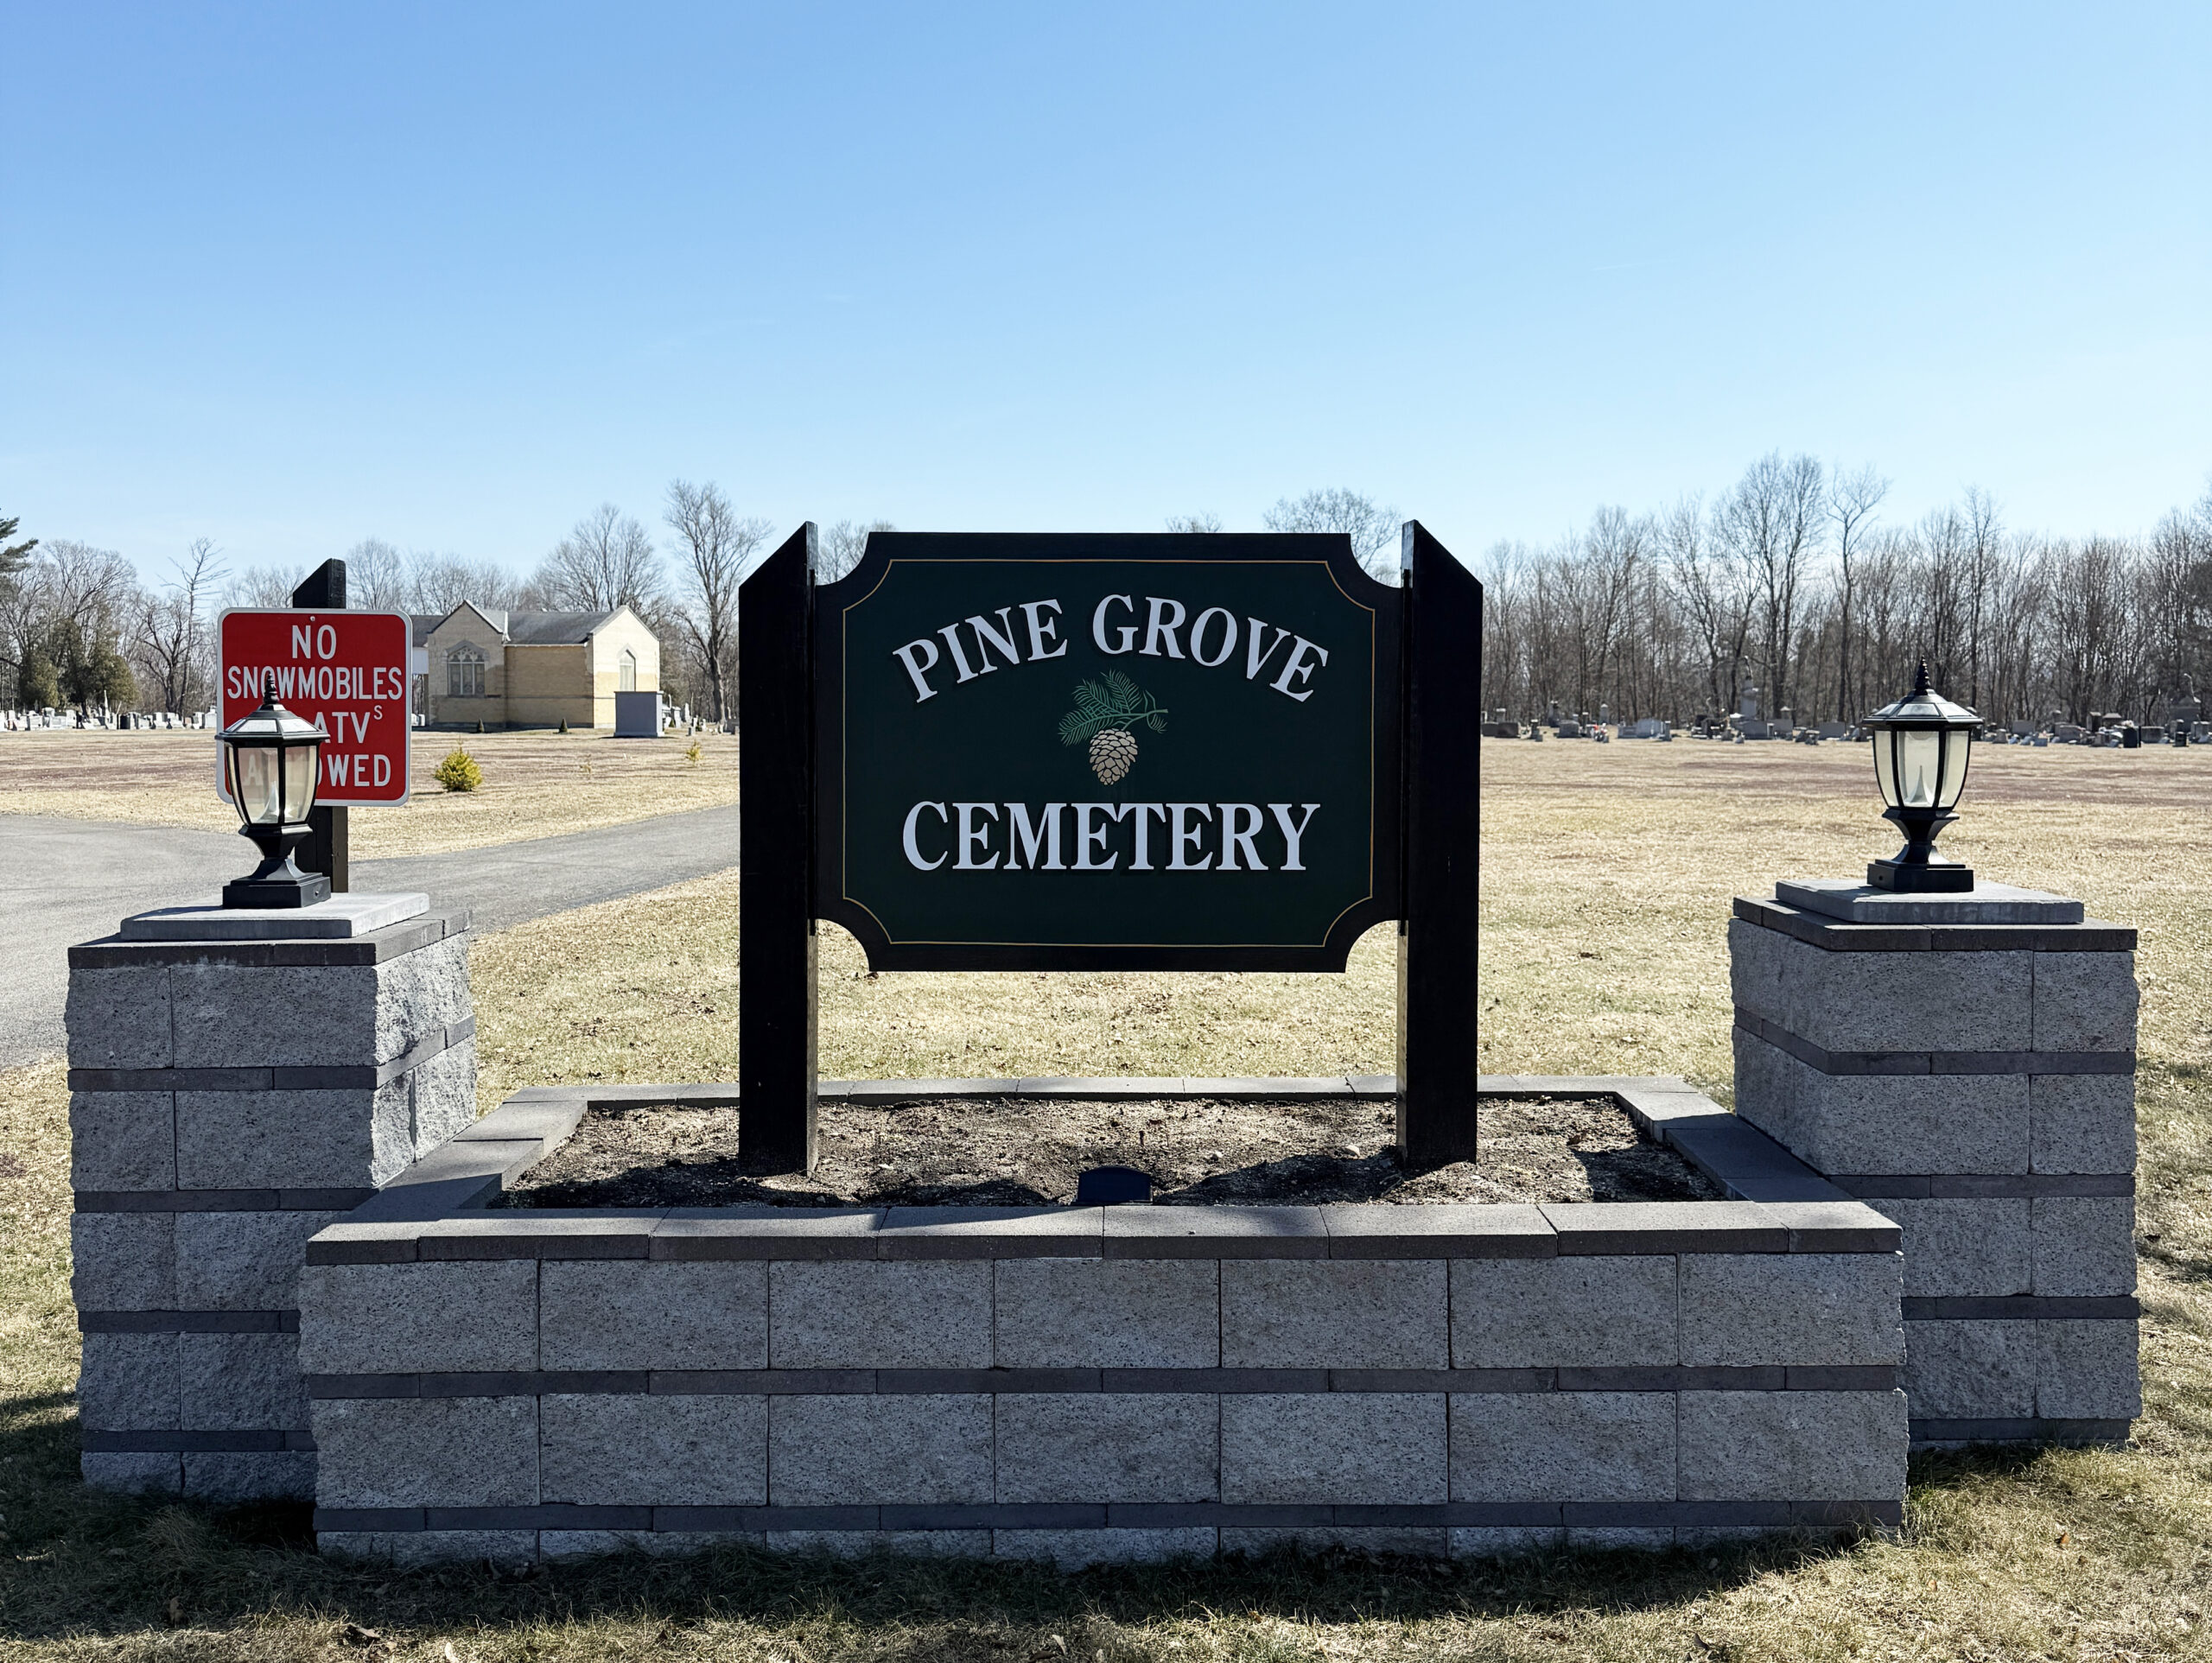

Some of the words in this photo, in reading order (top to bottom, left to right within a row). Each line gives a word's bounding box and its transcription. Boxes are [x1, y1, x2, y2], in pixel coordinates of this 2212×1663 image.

[291, 625, 337, 660] NO
[893, 599, 1068, 703] PINE
[1092, 594, 1329, 702] GROVE
[227, 666, 403, 701] SNOWMOBILES
[903, 801, 1320, 871] CEMETERY
